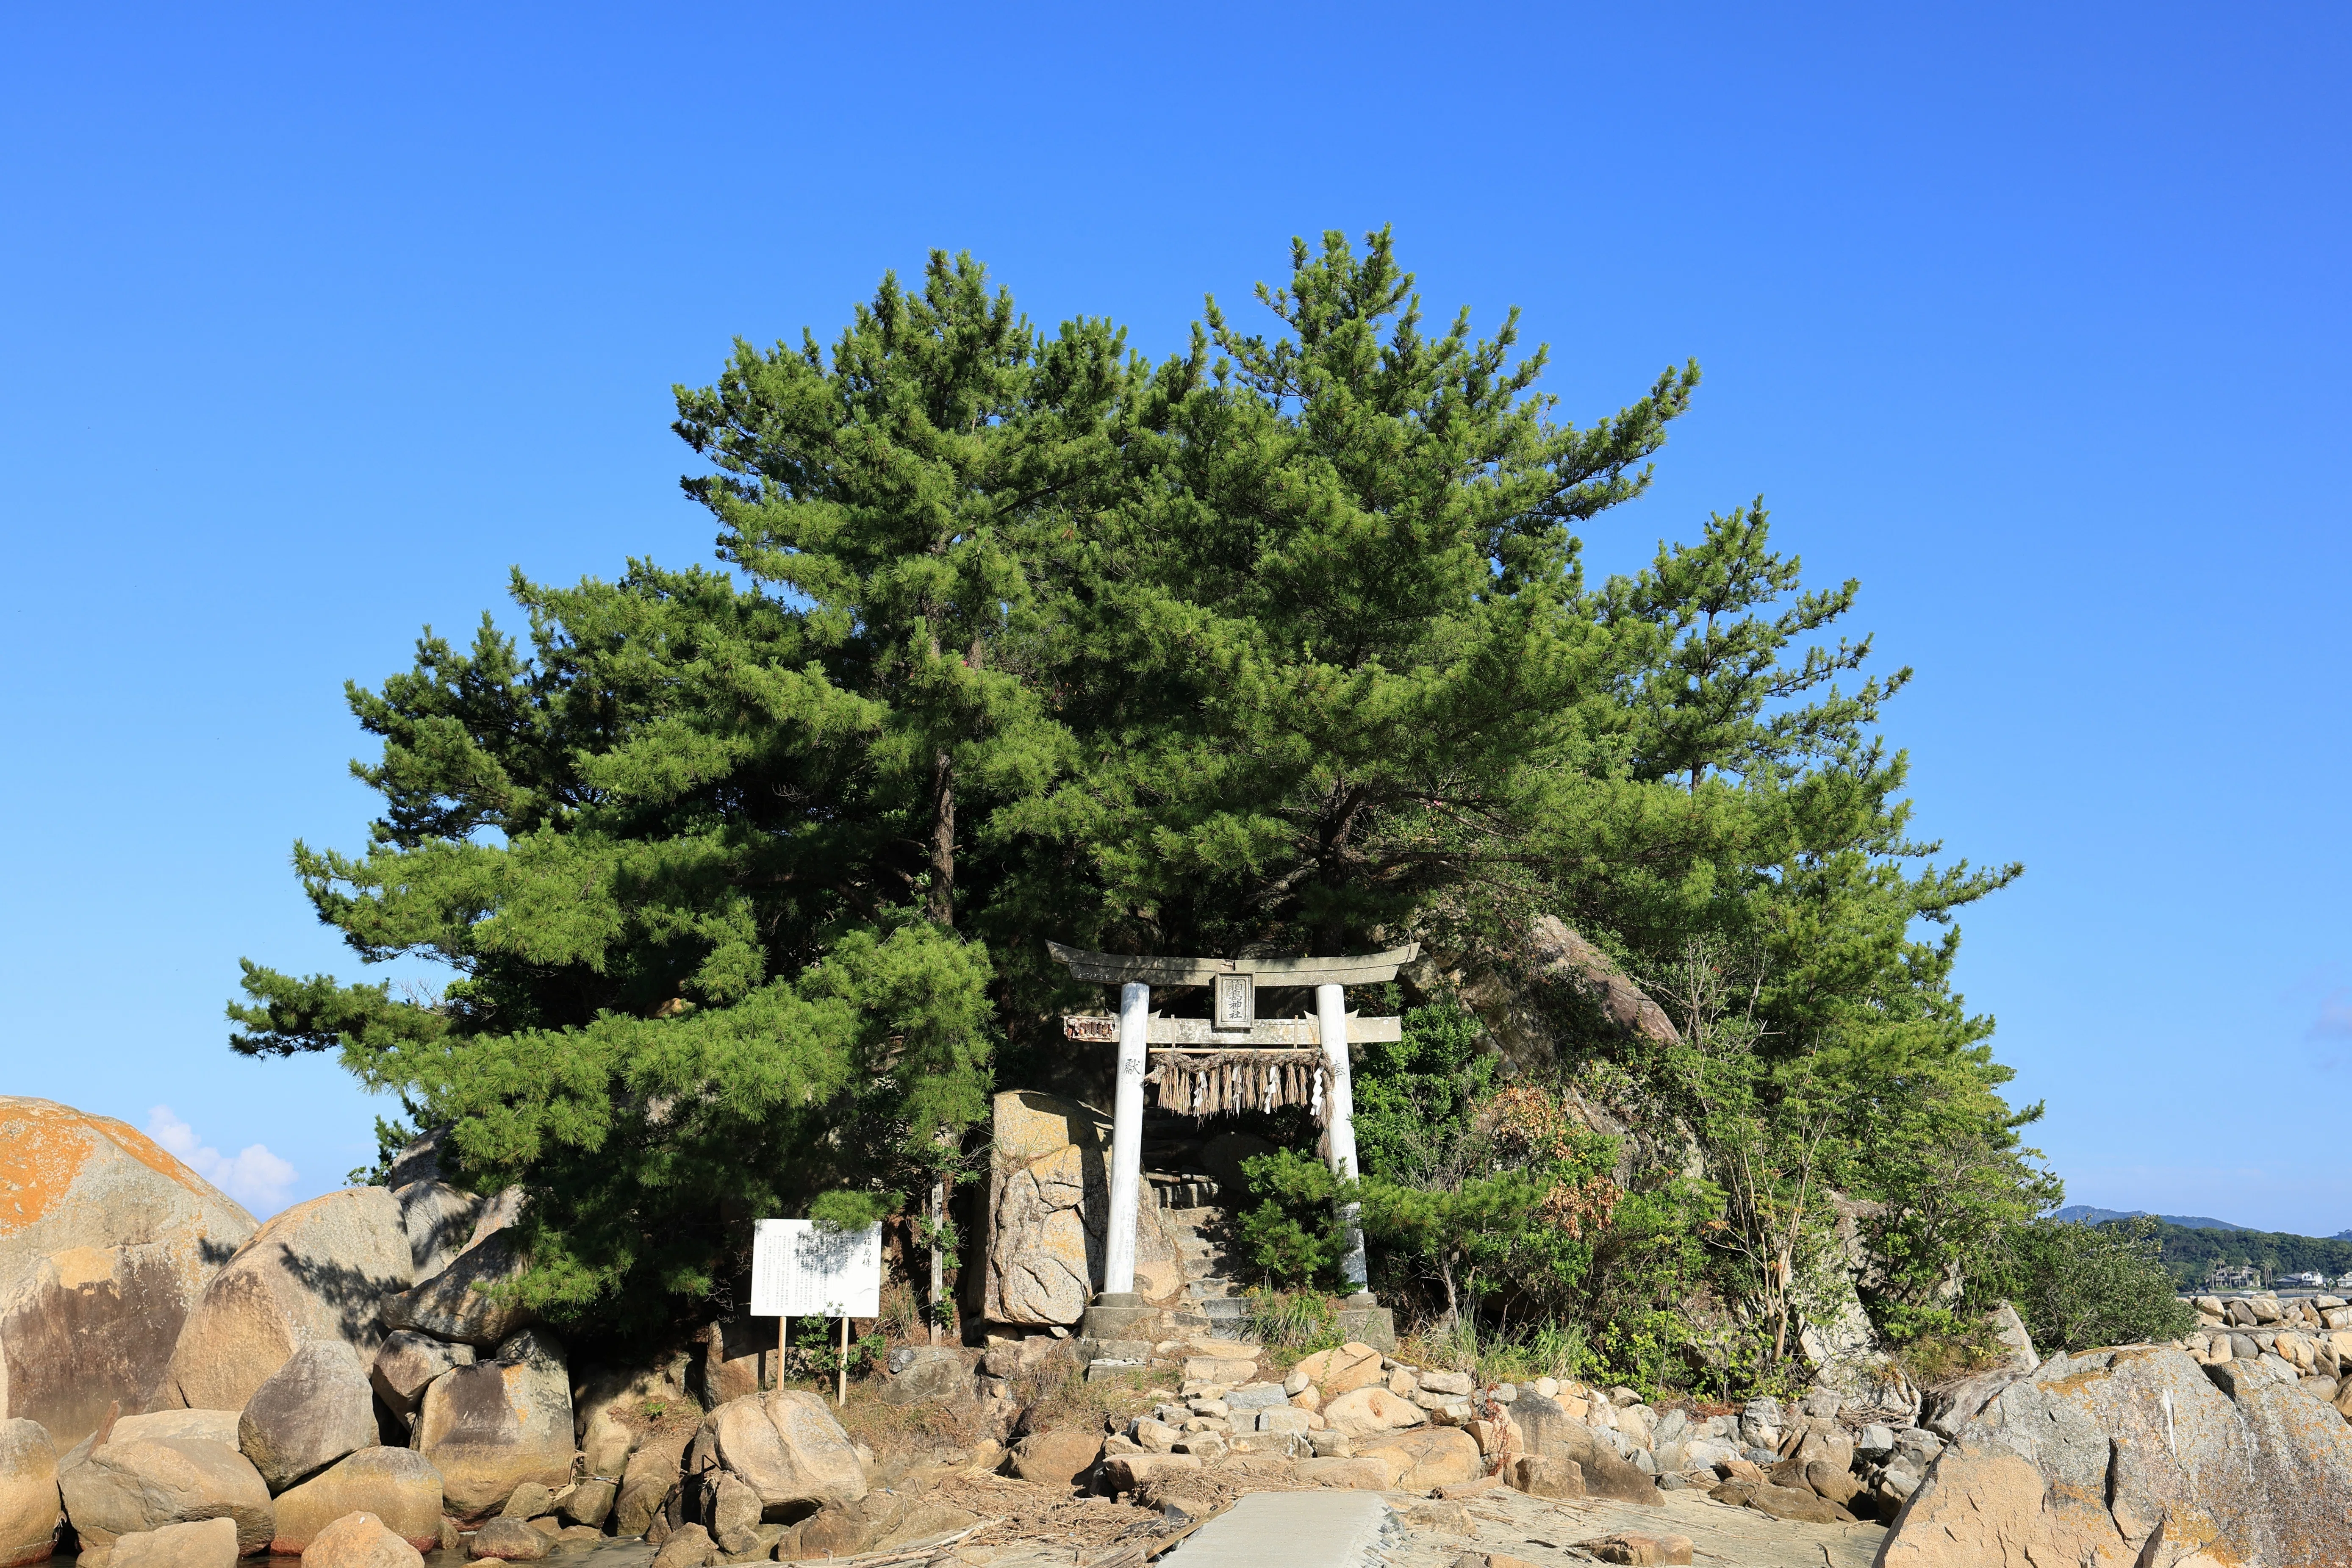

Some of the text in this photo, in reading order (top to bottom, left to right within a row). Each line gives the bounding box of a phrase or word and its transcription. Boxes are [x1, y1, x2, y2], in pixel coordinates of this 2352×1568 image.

[1228, 980, 1243, 1019] 箱島神社
[862, 1237, 871, 1267] 箱島様
